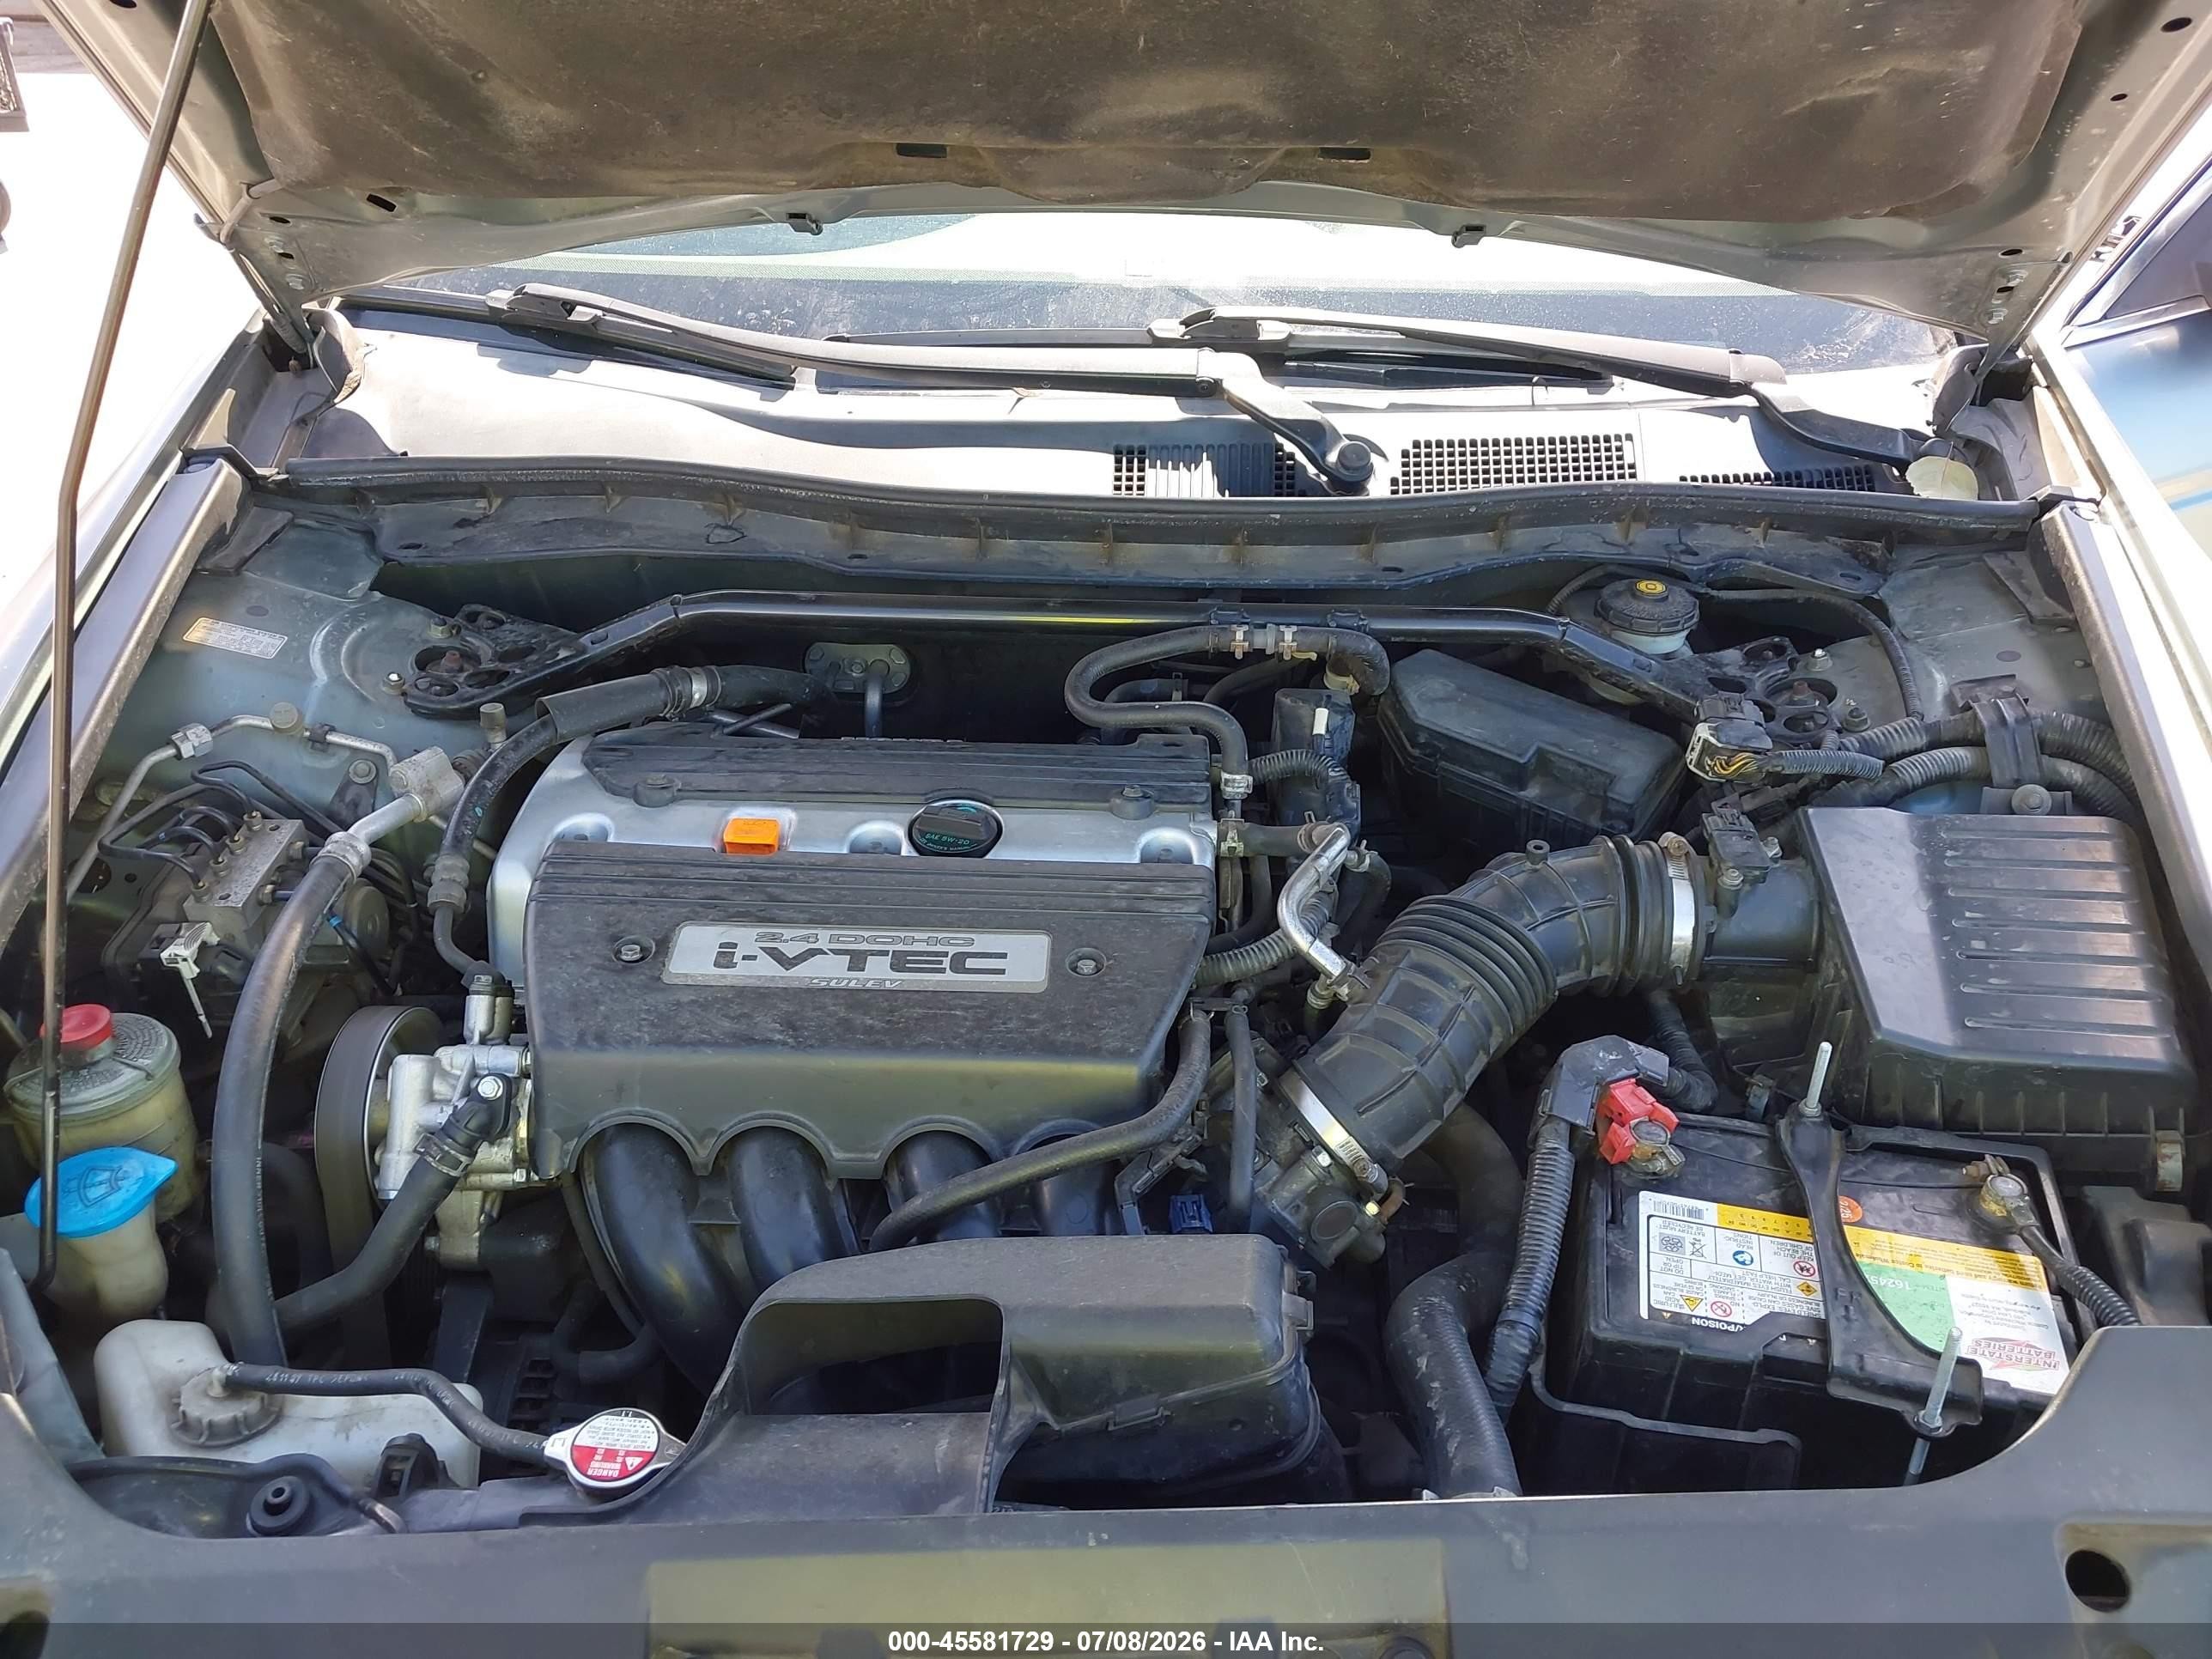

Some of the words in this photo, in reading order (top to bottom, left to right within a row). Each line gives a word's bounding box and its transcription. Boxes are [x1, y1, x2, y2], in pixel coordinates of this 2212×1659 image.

[755, 932, 819, 944] 2.4
[829, 933, 975, 947] DOHC
[714, 941, 1008, 976] i-VTEC
[808, 977, 903, 989] SULEV
[1691, 1316, 1744, 1333] /POISON
[1970, 1347, 2057, 1369] INTERSTATE
[1974, 1340, 2053, 1359] BATTERIES
[586, 1468, 619, 1478] DANGER
